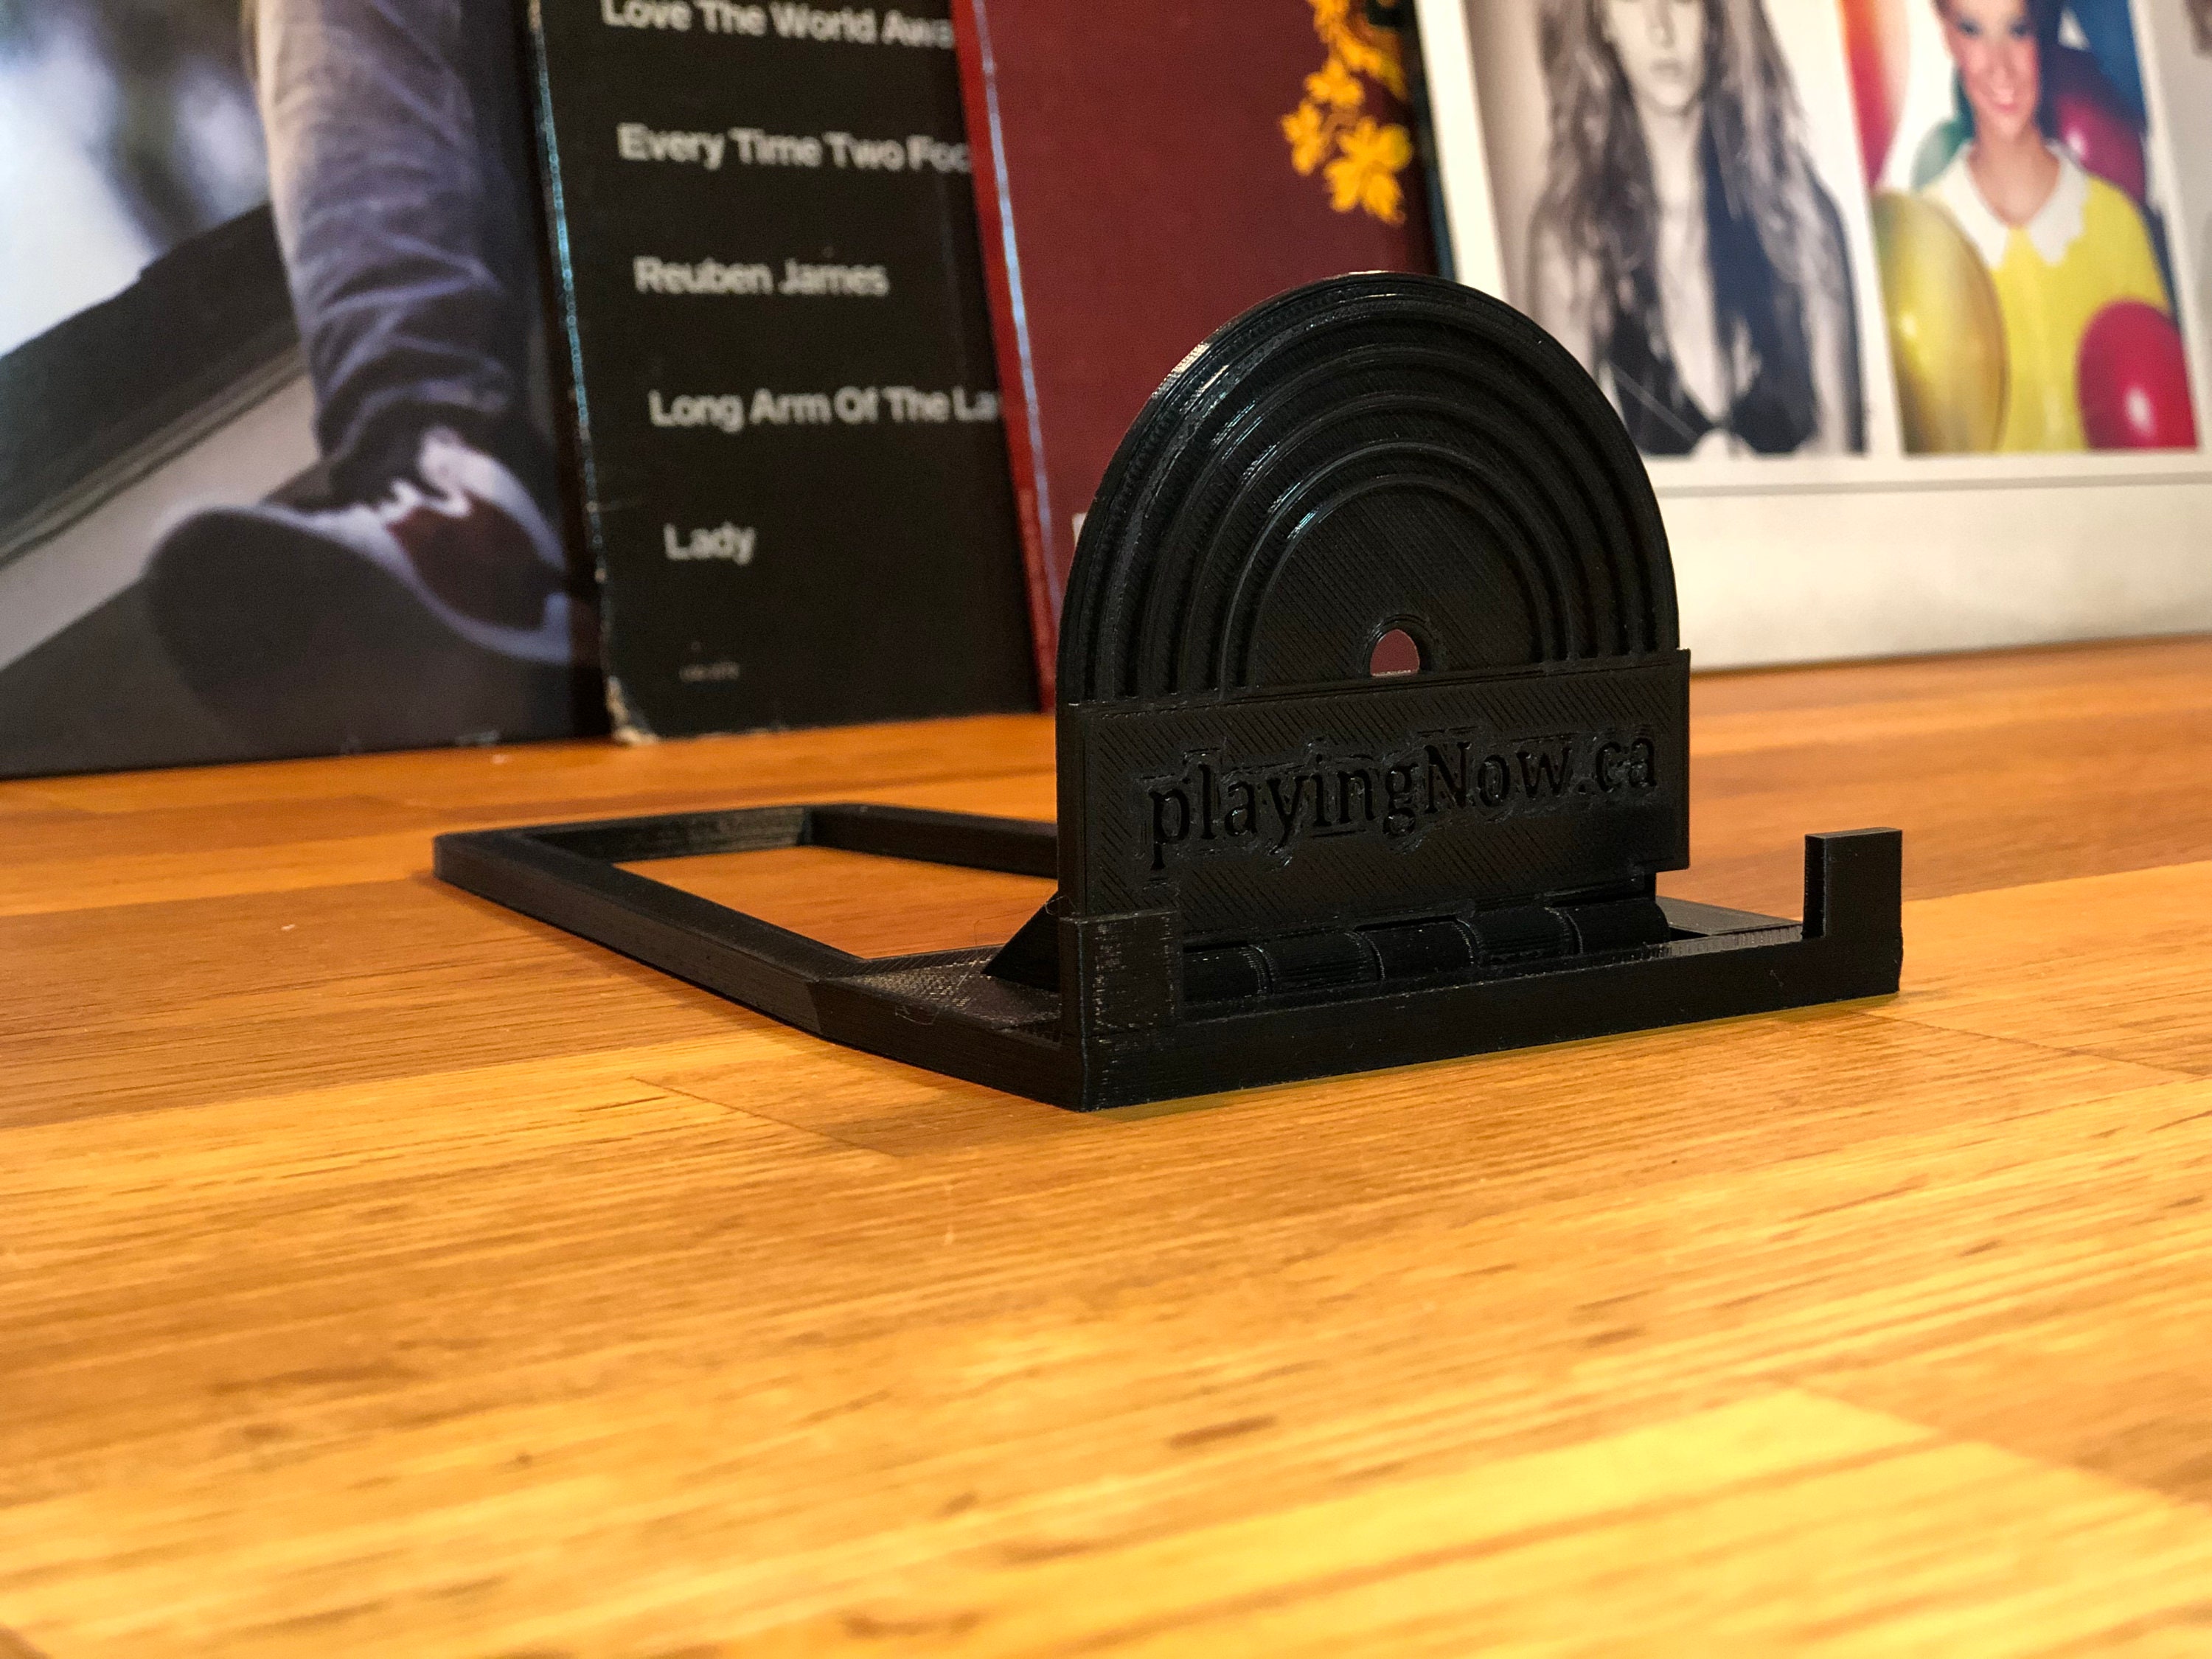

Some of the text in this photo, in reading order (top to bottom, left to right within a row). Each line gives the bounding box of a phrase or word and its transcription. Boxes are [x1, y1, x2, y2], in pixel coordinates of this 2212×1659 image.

[601, 0, 692, 31] Love
[694, 0, 766, 36] The
[769, 2, 877, 43] World
[616, 123, 725, 171] Every
[728, 127, 822, 167] Time
[821, 131, 905, 171] Two
[633, 256, 889, 296] Reuben James
[649, 388, 744, 434] Long
[748, 387, 832, 425] Arm
[834, 385, 879, 424] Of
[882, 386, 950, 423] The
[664, 521, 756, 566] Lady
[1147, 734, 1658, 872] playingNow.ca
